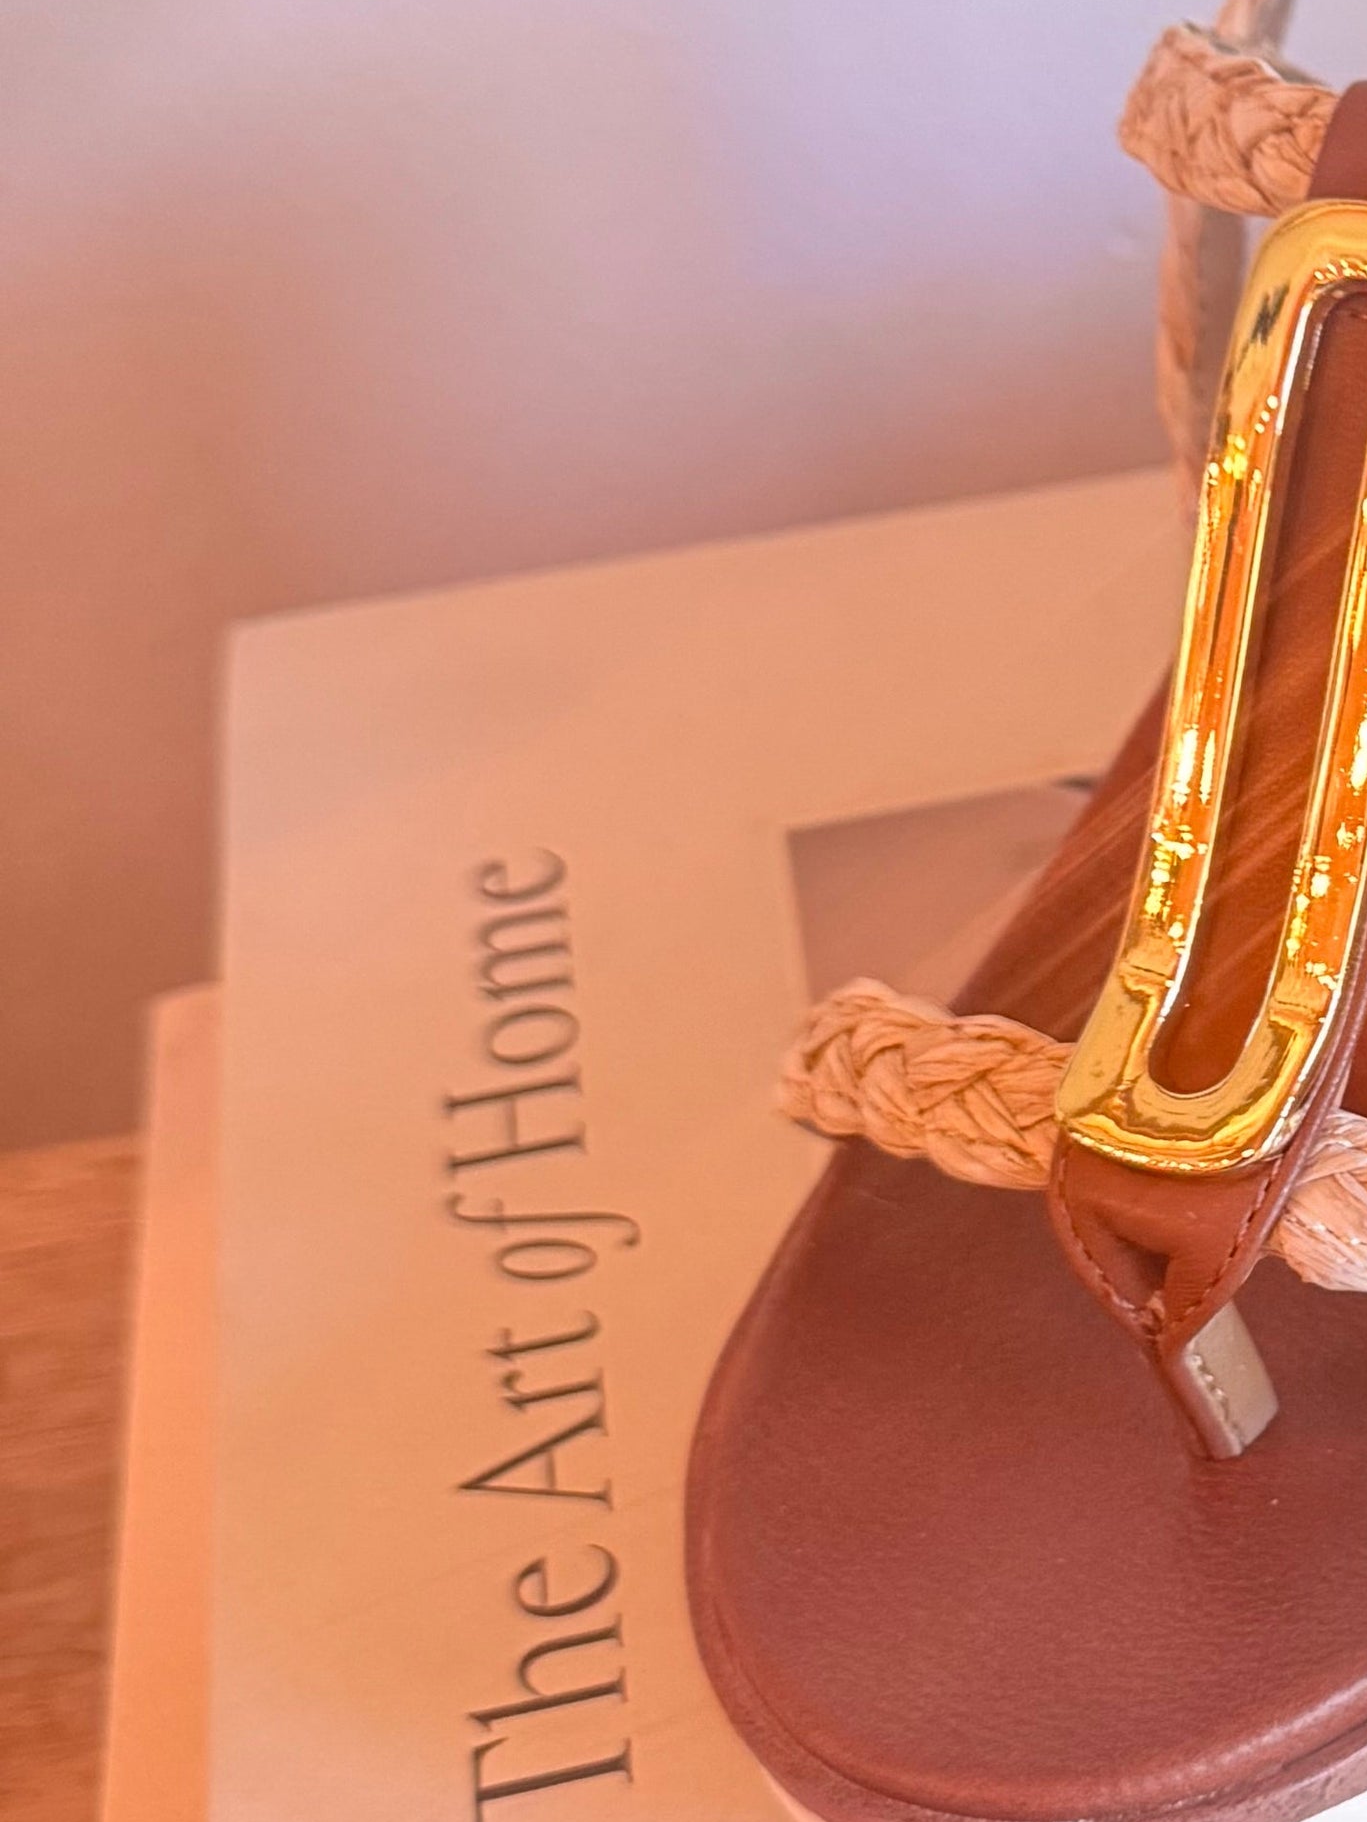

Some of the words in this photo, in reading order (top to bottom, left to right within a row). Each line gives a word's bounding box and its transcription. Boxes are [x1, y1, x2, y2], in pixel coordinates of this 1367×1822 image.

[441, 846, 586, 1178] Home
[447, 1188, 640, 1282] of
[457, 1309, 612, 1512] Art
